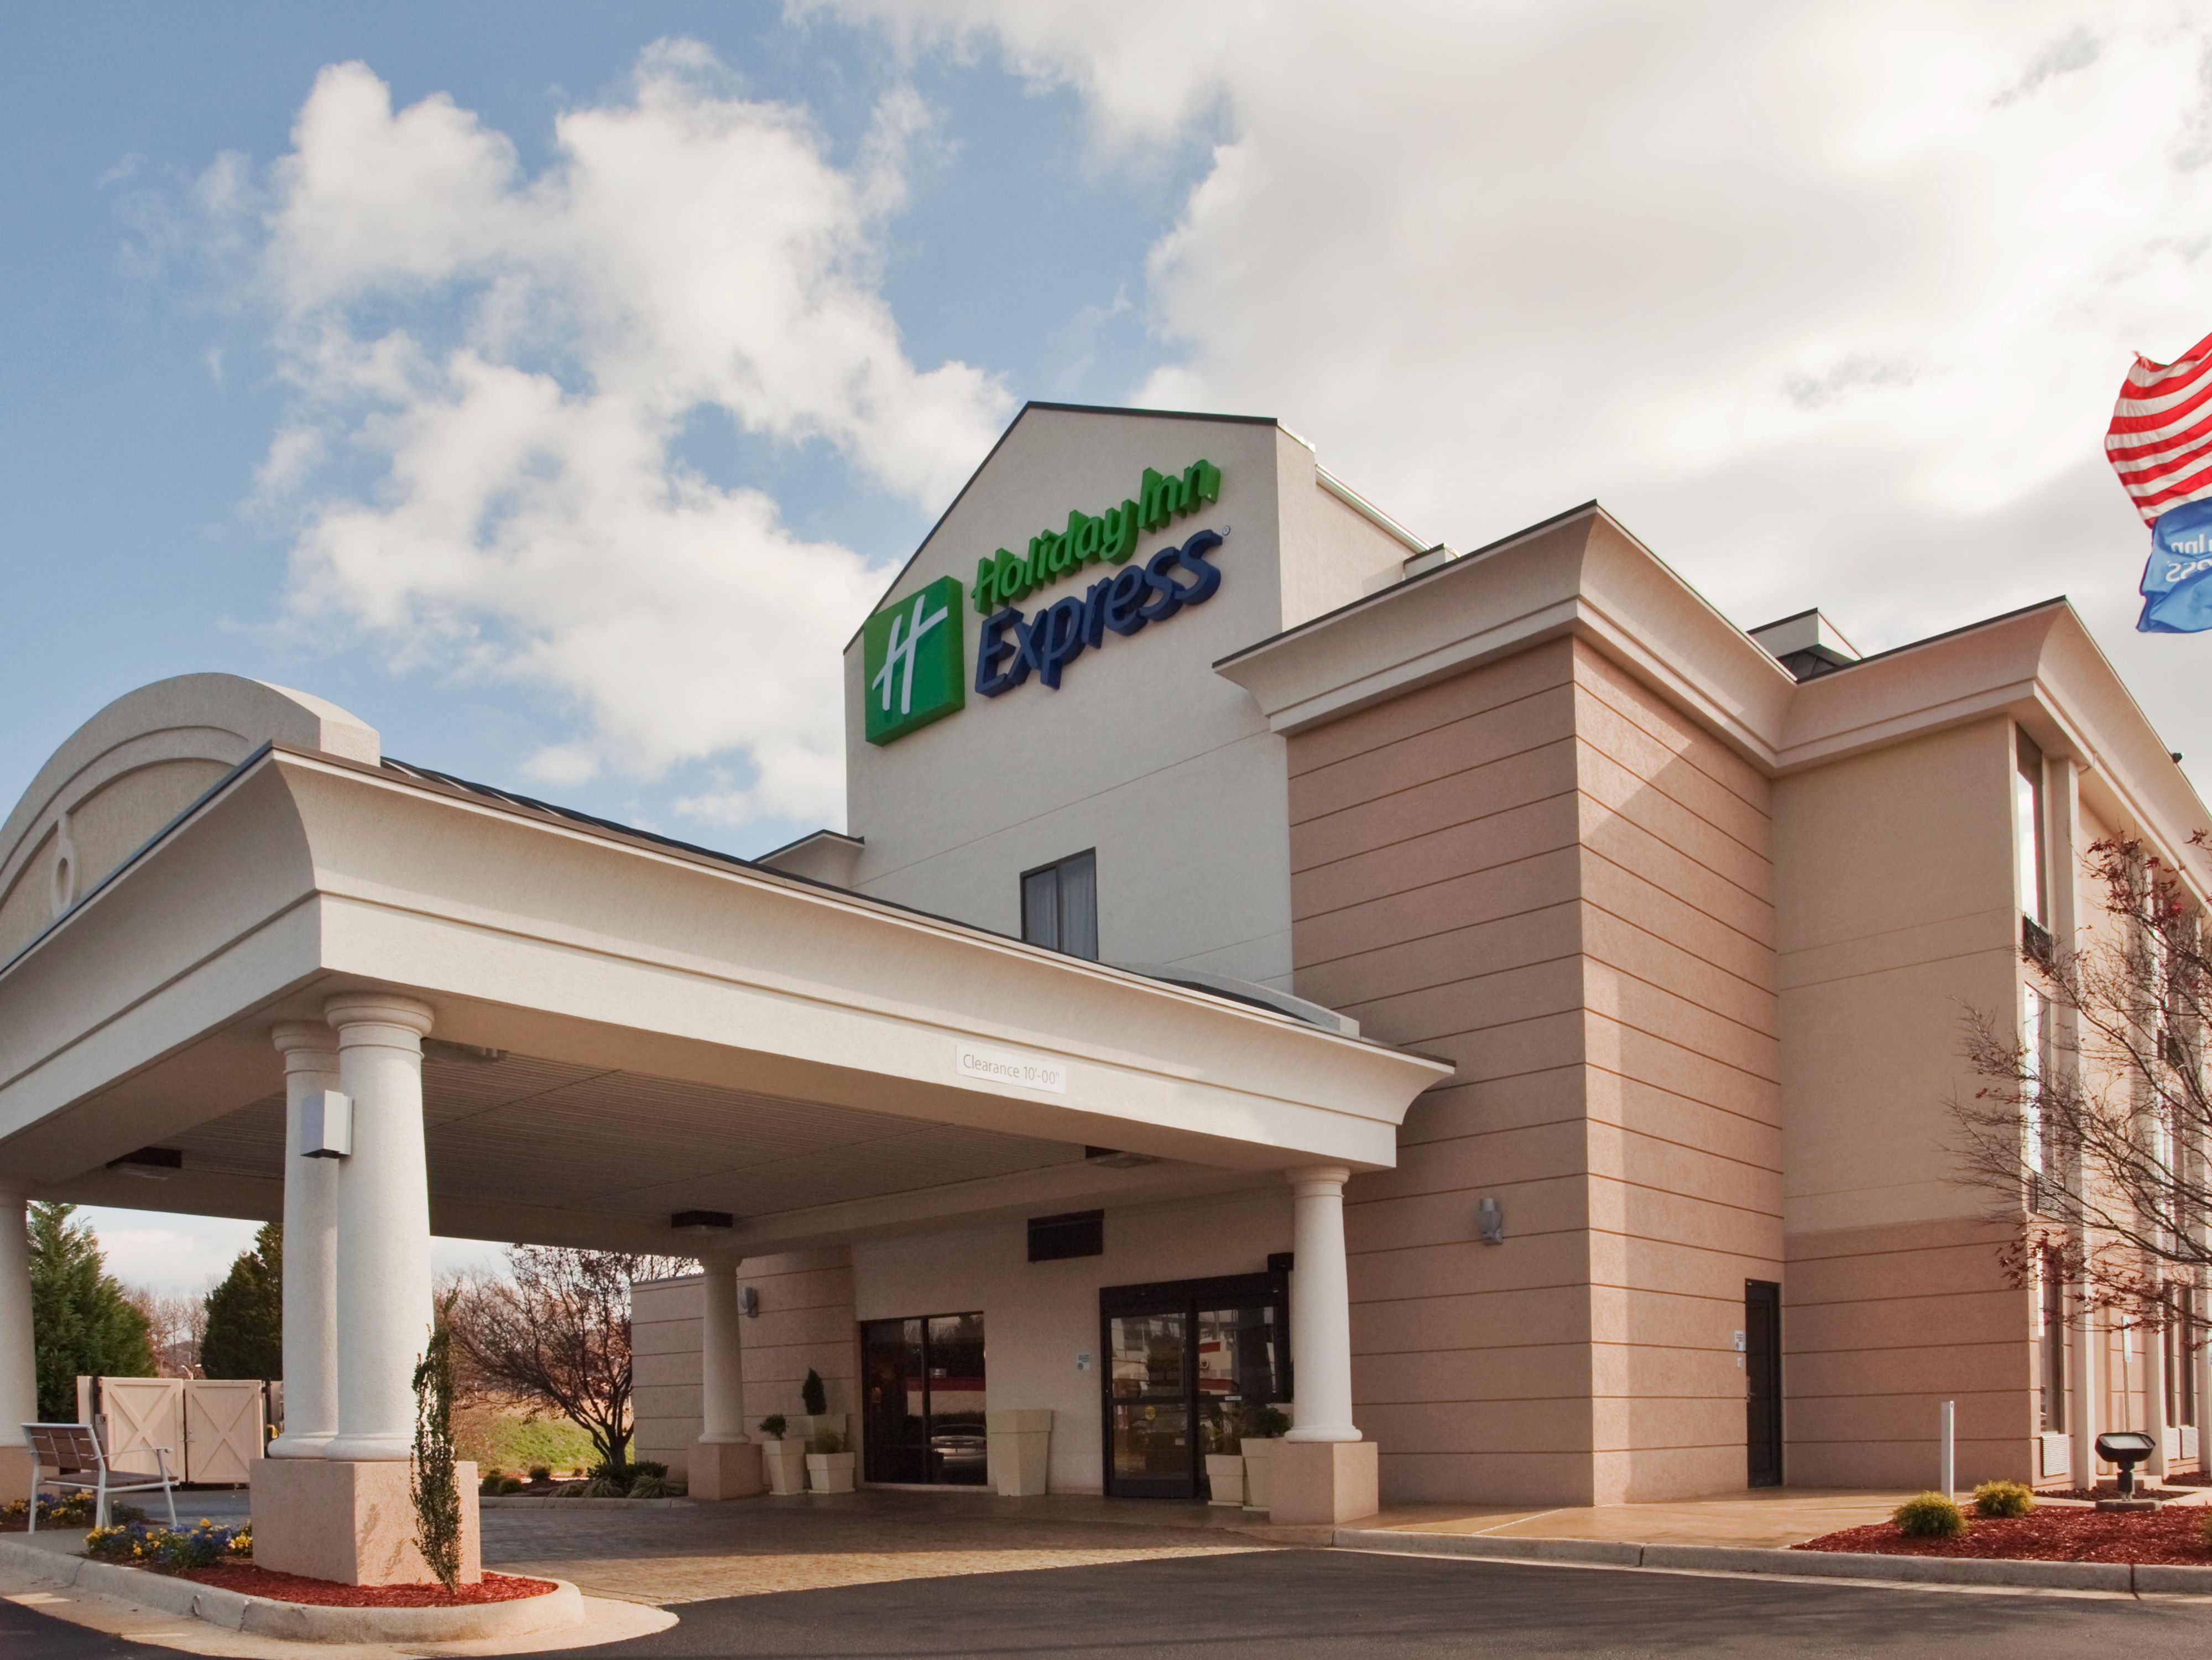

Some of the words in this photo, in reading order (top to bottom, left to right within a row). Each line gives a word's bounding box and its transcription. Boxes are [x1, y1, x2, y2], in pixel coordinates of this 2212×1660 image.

[971, 499, 1139, 616] Holiday
[1138, 459, 1221, 533] Inn
[975, 529, 1223, 698] Express
[963, 1054, 1020, 1078] Clearance
[1024, 1066, 1060, 1085] 10'-00"
